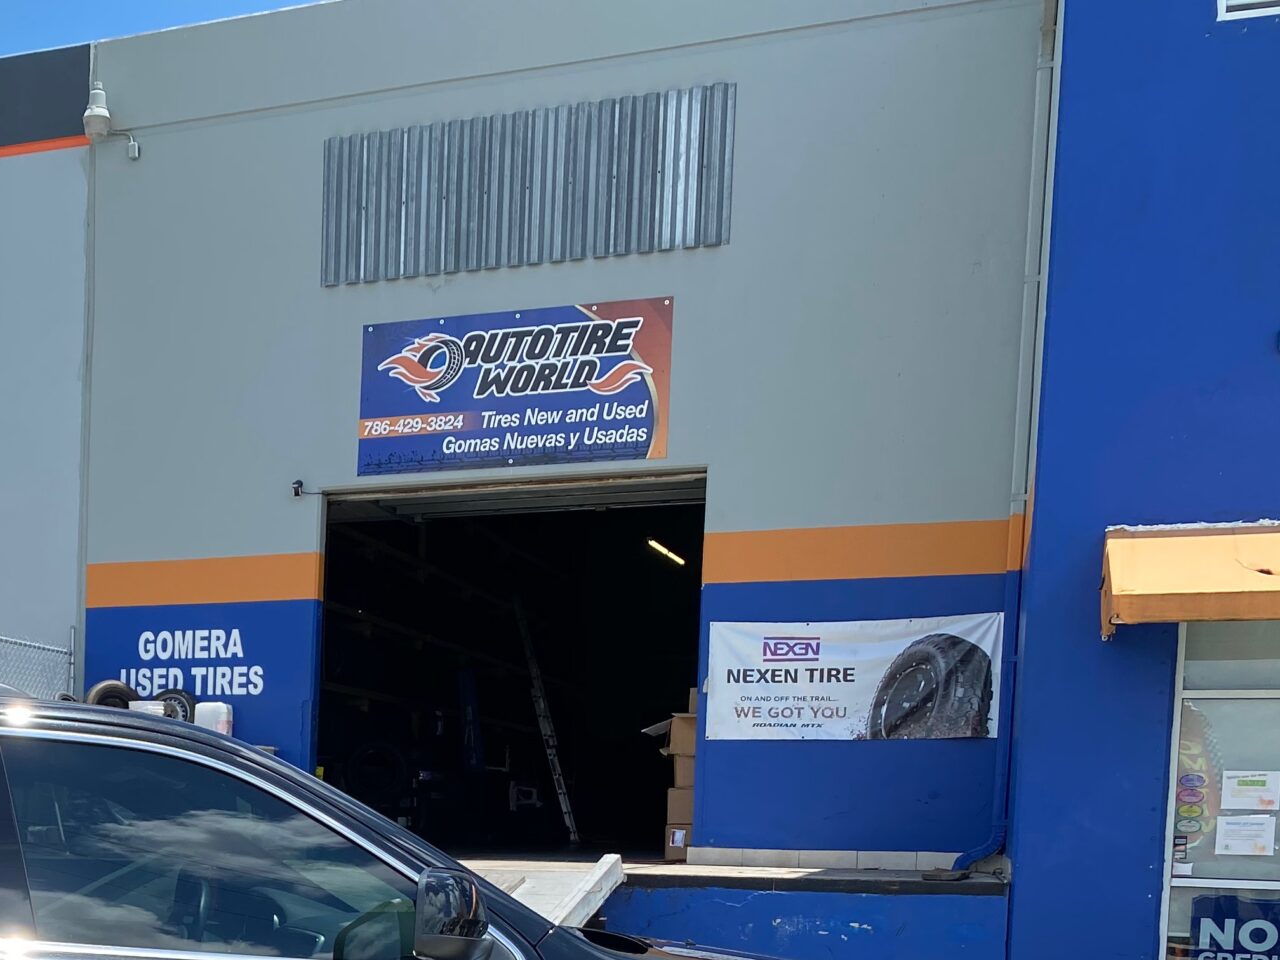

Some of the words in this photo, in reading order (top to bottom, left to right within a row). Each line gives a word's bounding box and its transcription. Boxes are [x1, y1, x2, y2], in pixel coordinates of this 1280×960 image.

[463, 317, 644, 368] AUTOTIRE
[473, 357, 600, 399] WORLD
[364, 414, 464, 436] 786-429-3824
[481, 410, 520, 429] Tires
[524, 407, 562, 427] New
[565, 404, 600, 423] and
[603, 400, 649, 420] Used
[442, 436, 499, 454] Gomas
[503, 431, 565, 451] Nuevas
[568, 432, 579, 450] y
[583, 425, 648, 445] Usadas
[138, 628, 244, 661] GOMERA
[762, 641, 820, 657] NEXEN
[120, 667, 184, 698] USED
[191, 665, 265, 696] TIRES
[727, 668, 798, 684] NEXEN
[805, 667, 856, 683] TIRE
[734, 706, 762, 719] WE
[767, 706, 805, 719] GOT
[810, 706, 848, 719] YOU
[1198, 917, 1279, 953] NO
